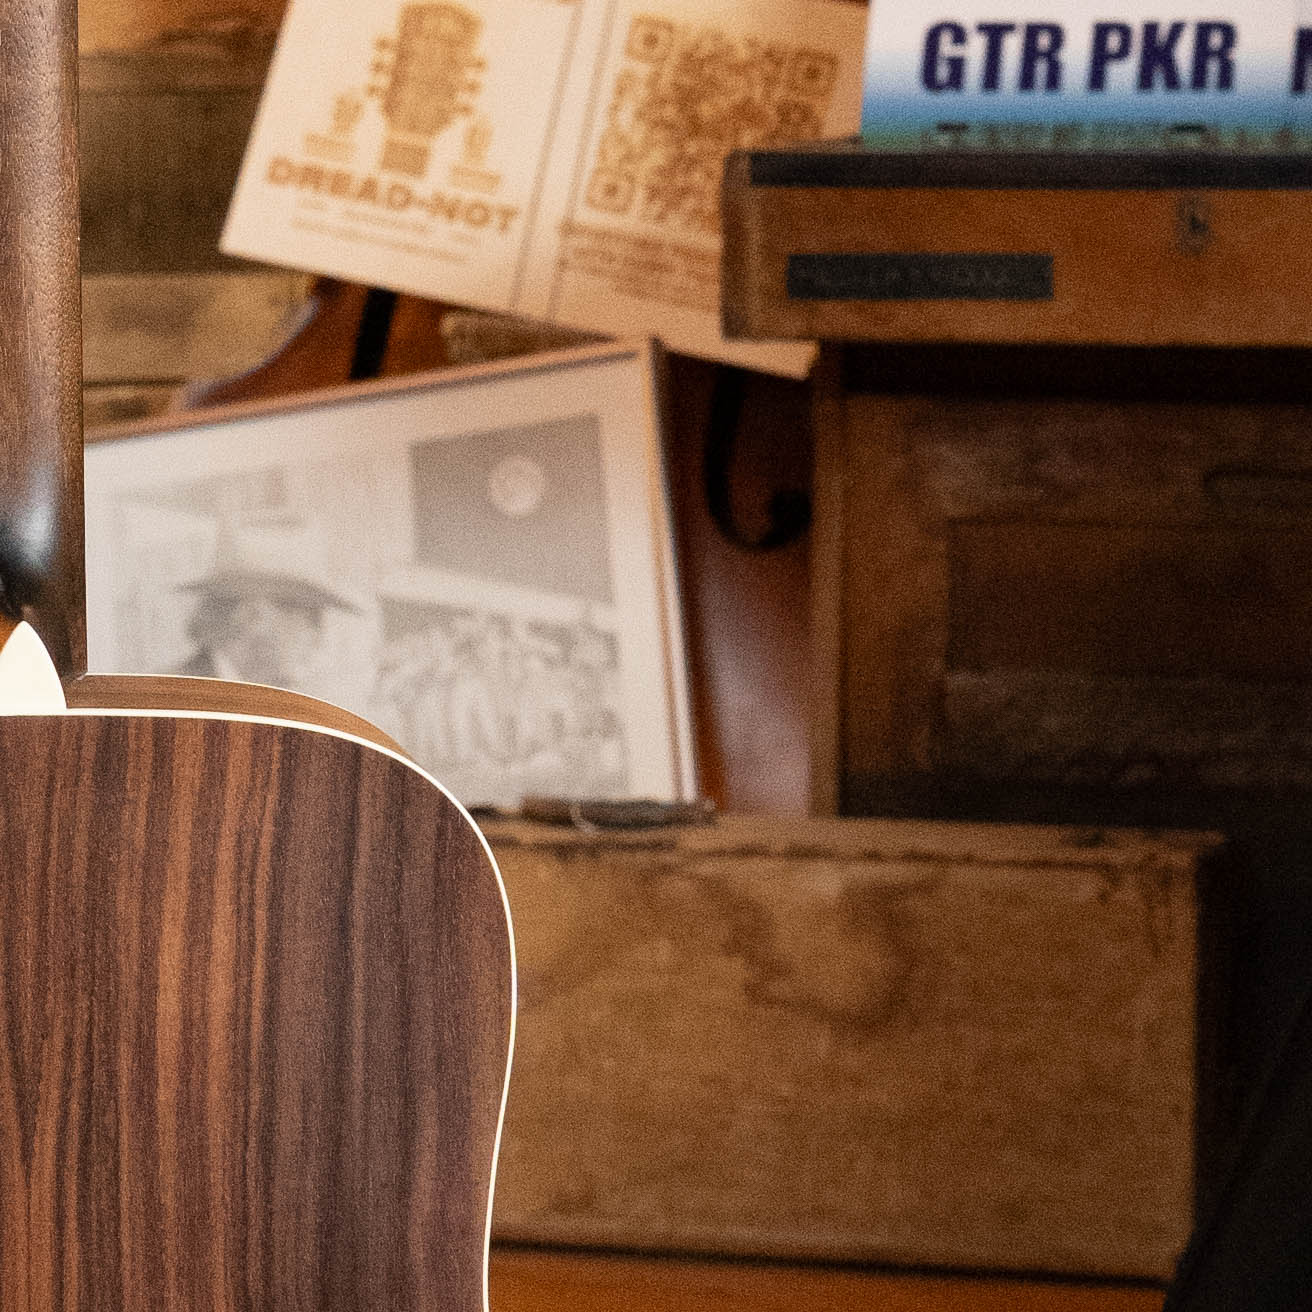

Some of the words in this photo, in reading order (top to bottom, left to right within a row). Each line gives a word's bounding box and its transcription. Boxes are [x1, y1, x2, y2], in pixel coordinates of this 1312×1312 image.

[920, 20, 1066, 95] GTR
[1089, 19, 1239, 95] PKR
[265, 157, 520, 236] DREAD-NOT
